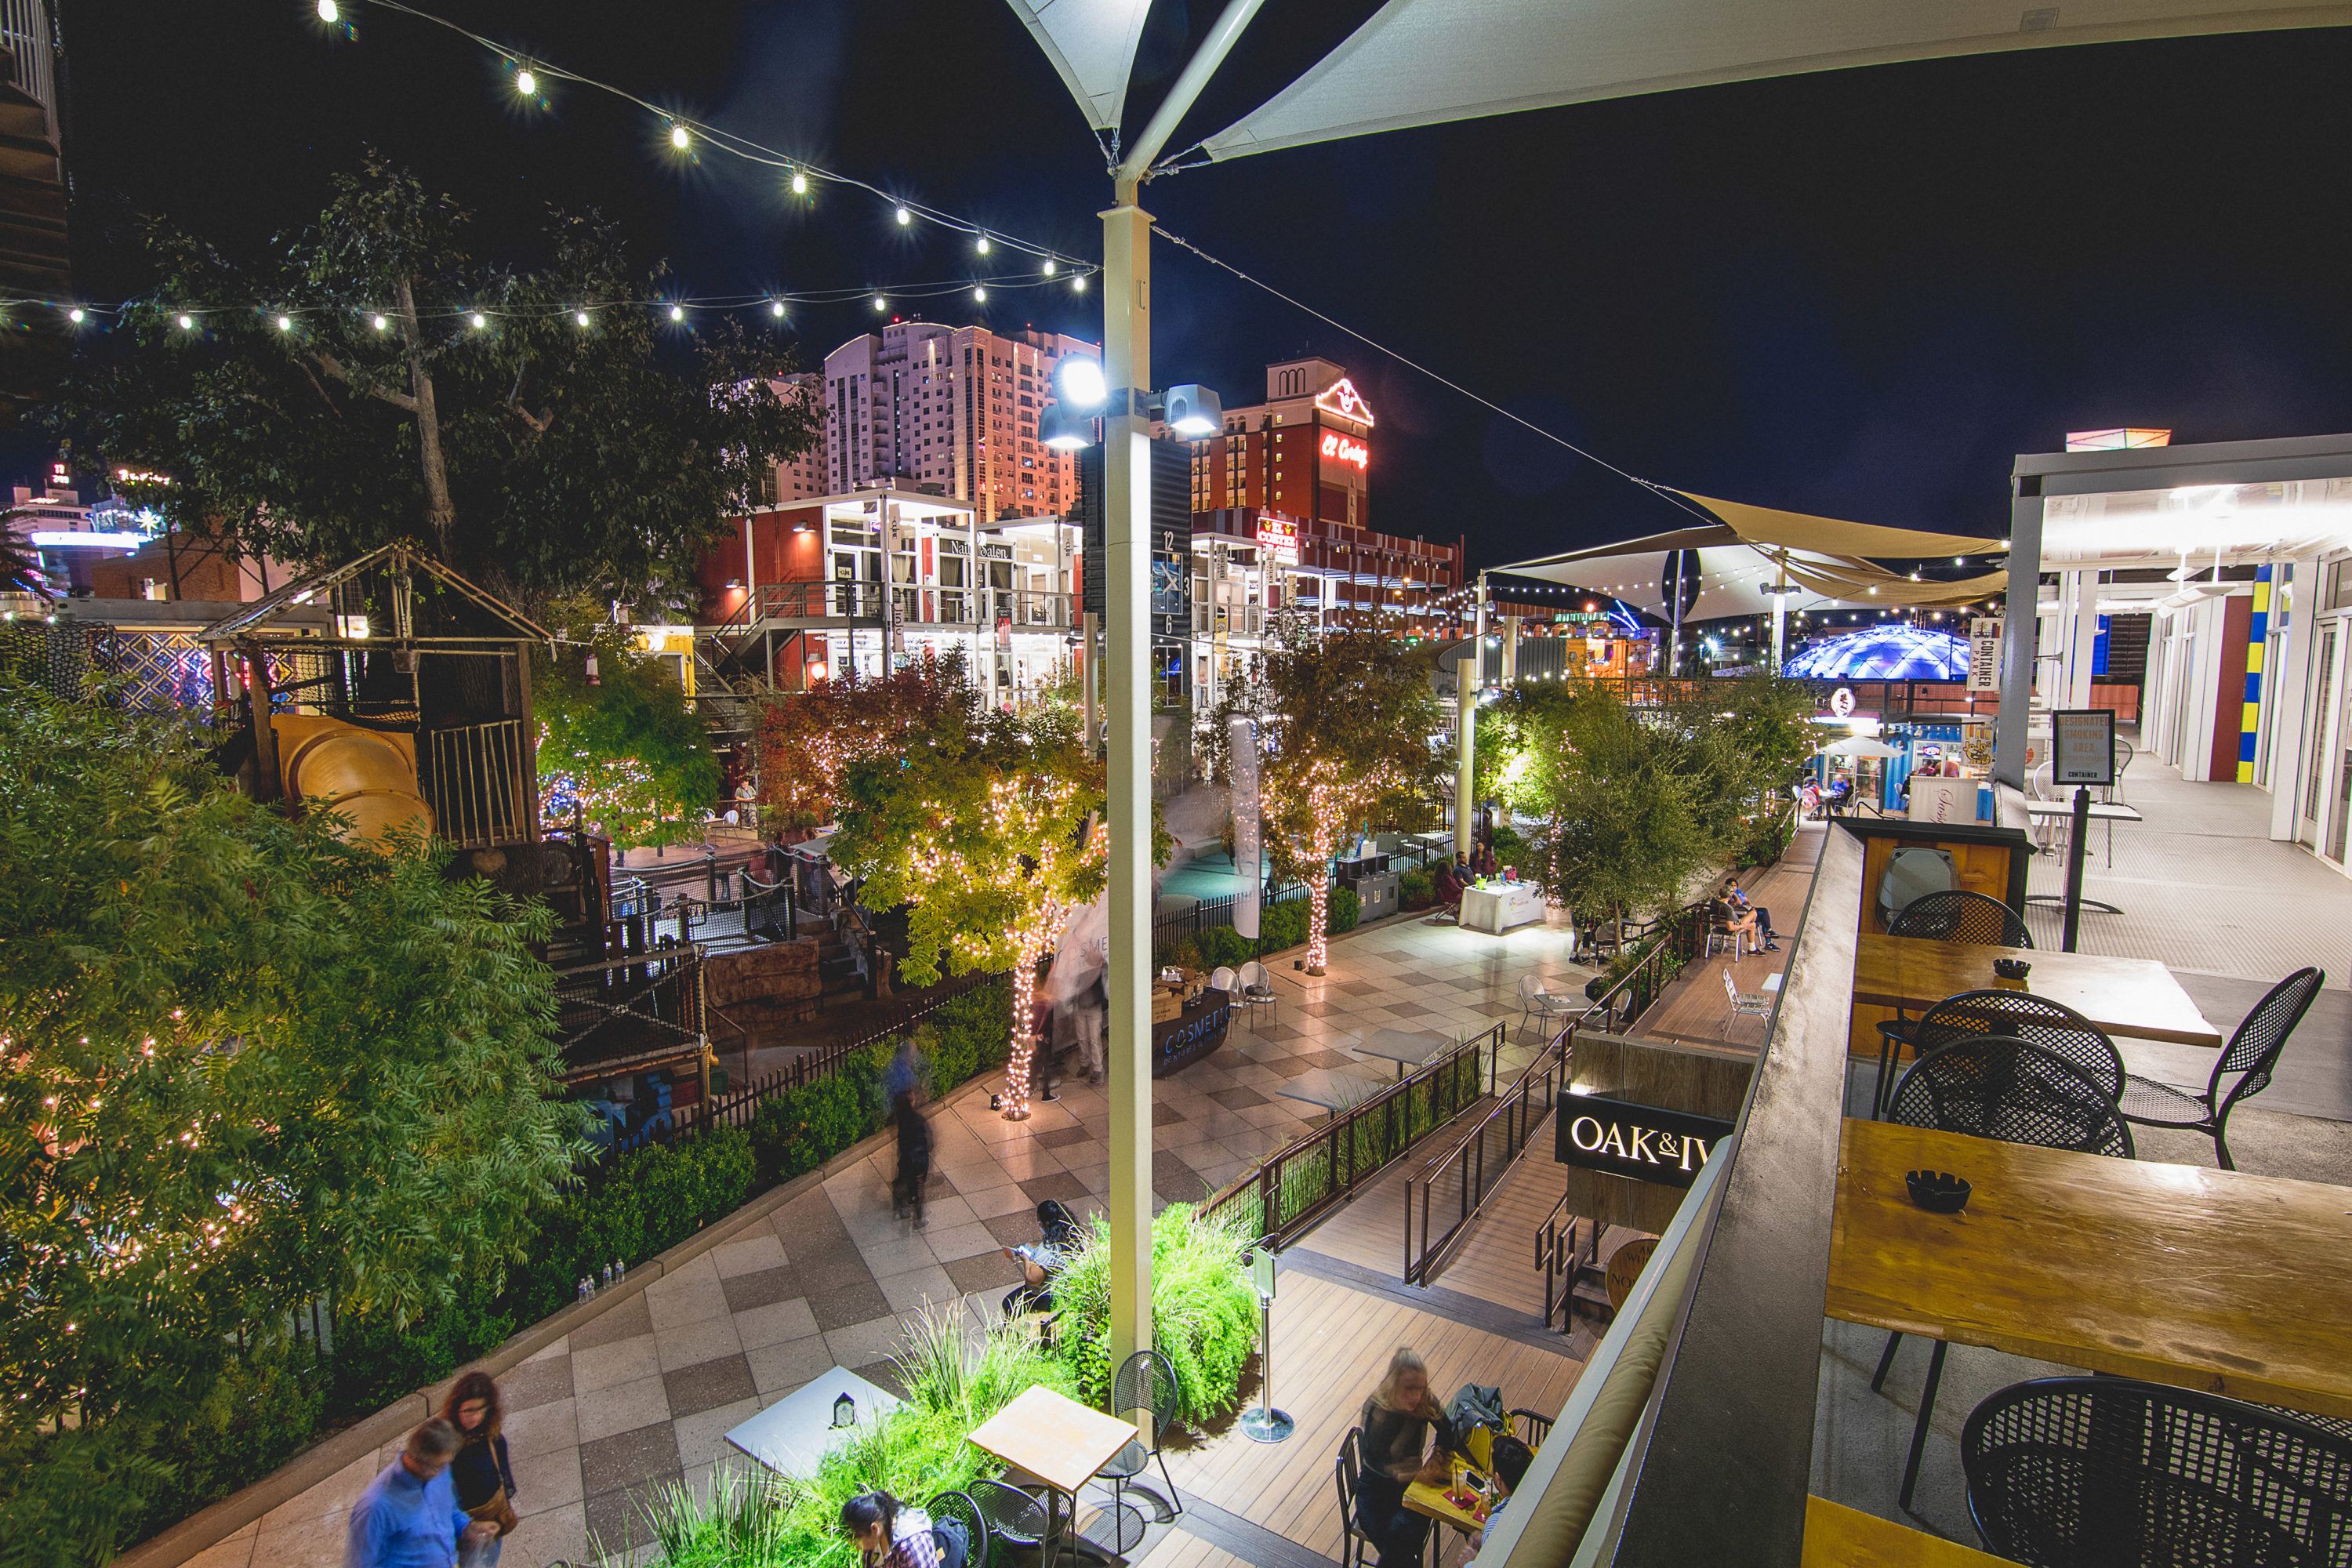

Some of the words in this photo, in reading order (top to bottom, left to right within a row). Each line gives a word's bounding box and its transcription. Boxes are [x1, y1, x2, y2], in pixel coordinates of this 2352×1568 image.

[1322, 434, 1338, 457] El
[1271, 521, 1284, 534] EL
[1163, 531, 1174, 550] 12
[980, 545, 1008, 559] Salon
[1184, 577, 1190, 596] 3
[1165, 615, 1172, 634] 6
[1978, 641, 1994, 687] CONTAINER
[2060, 716, 2109, 727] DESIGNATED
[2064, 729, 2104, 739] SMOKING
[2073, 742, 2096, 753] AREA
